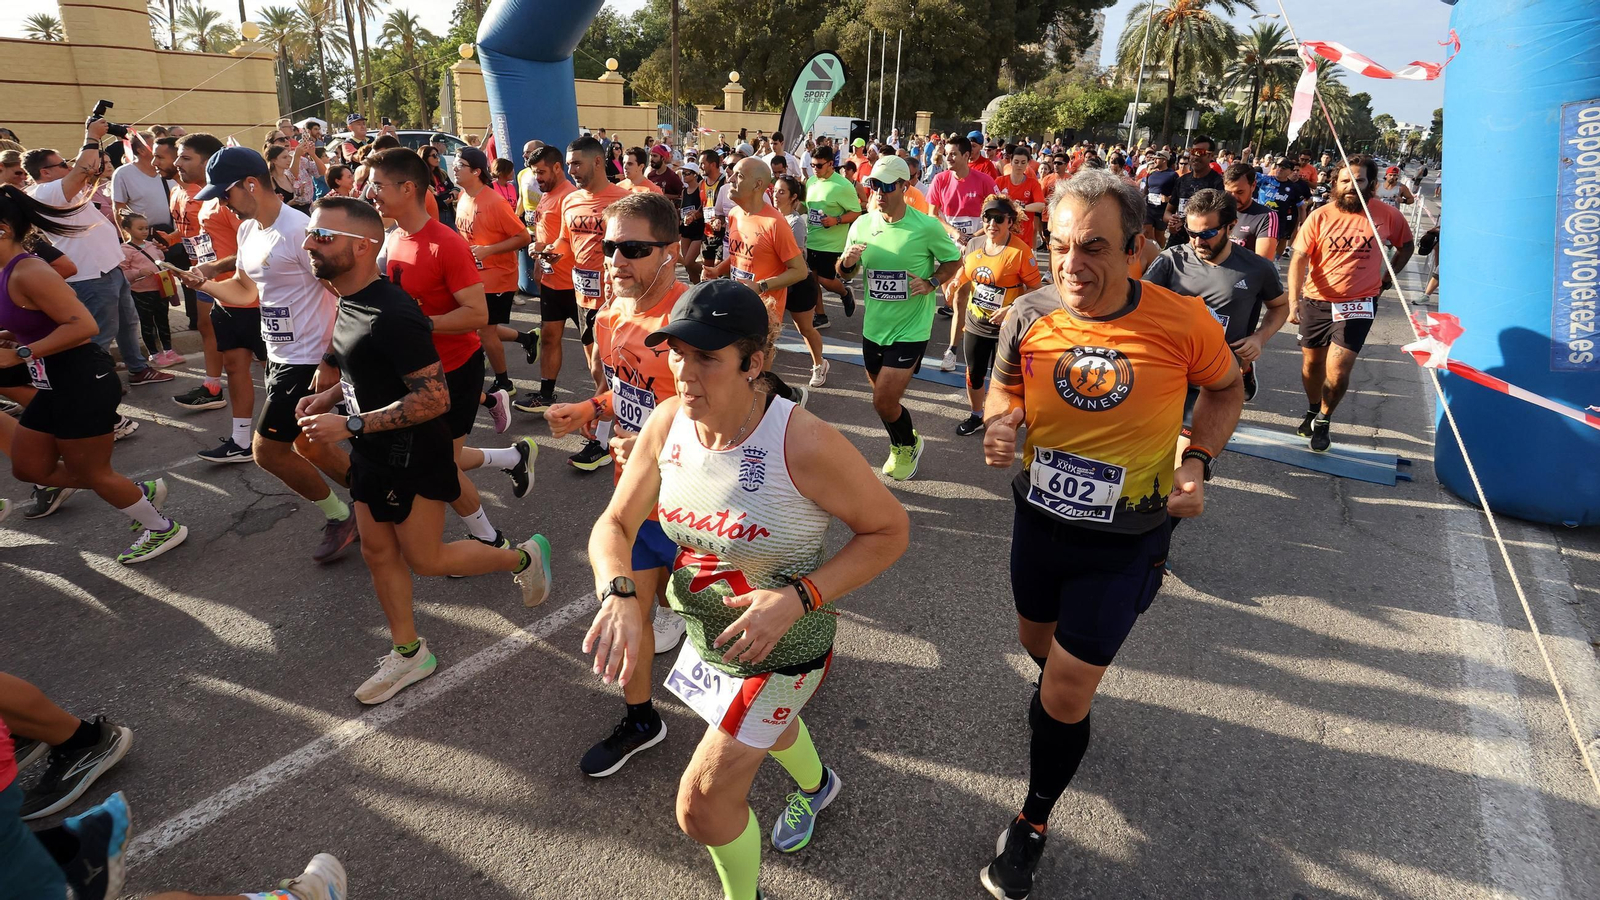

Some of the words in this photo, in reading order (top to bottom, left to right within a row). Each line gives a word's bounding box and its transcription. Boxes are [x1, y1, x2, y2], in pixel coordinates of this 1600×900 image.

[875, 280, 897, 291] 762
[1341, 303, 1363, 311] 336
[1073, 346, 1117, 360] BEER
[1056, 379, 1128, 410] RUNNERS
[620, 400, 642, 424] 809
[1049, 472, 1096, 503] 602
[676, 532, 727, 555] JEREZ
